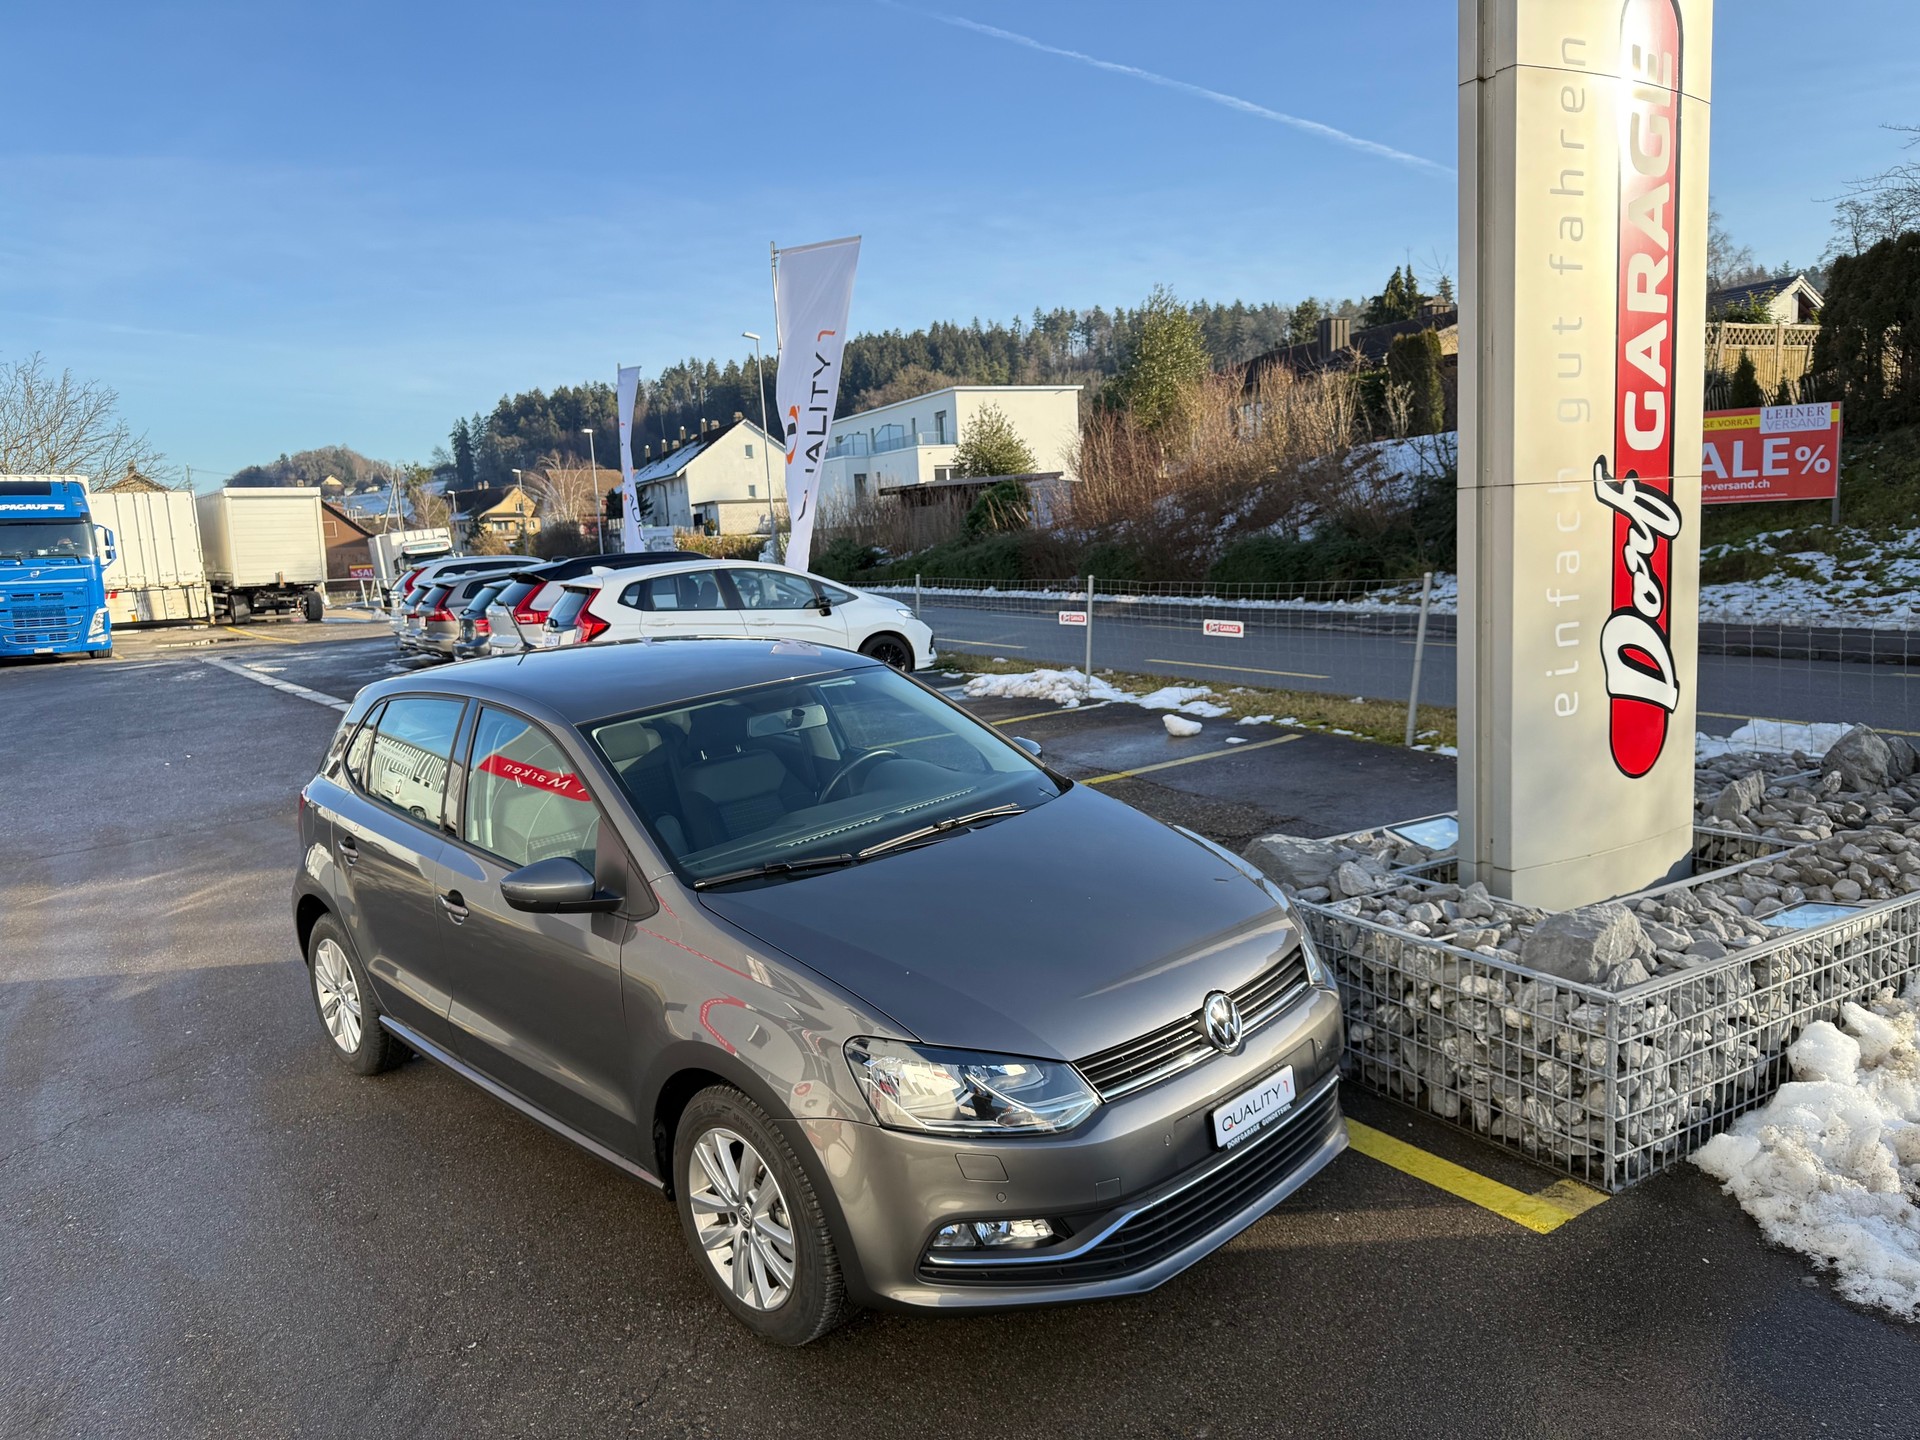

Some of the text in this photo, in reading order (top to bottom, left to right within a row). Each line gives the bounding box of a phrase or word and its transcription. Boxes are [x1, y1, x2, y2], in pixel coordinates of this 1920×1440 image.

[1546, 37, 1590, 718] einfach gut fahren
[1594, 44, 1681, 712] Dorf GARAGE
[1766, 406, 1826, 420] LEHNER
[1717, 418, 1753, 428] VORRAT
[1766, 417, 1826, 431] VERSAND
[1702, 480, 1770, 491] r-versand.ch
[1222, 1080, 1289, 1132] QUALITY 1
